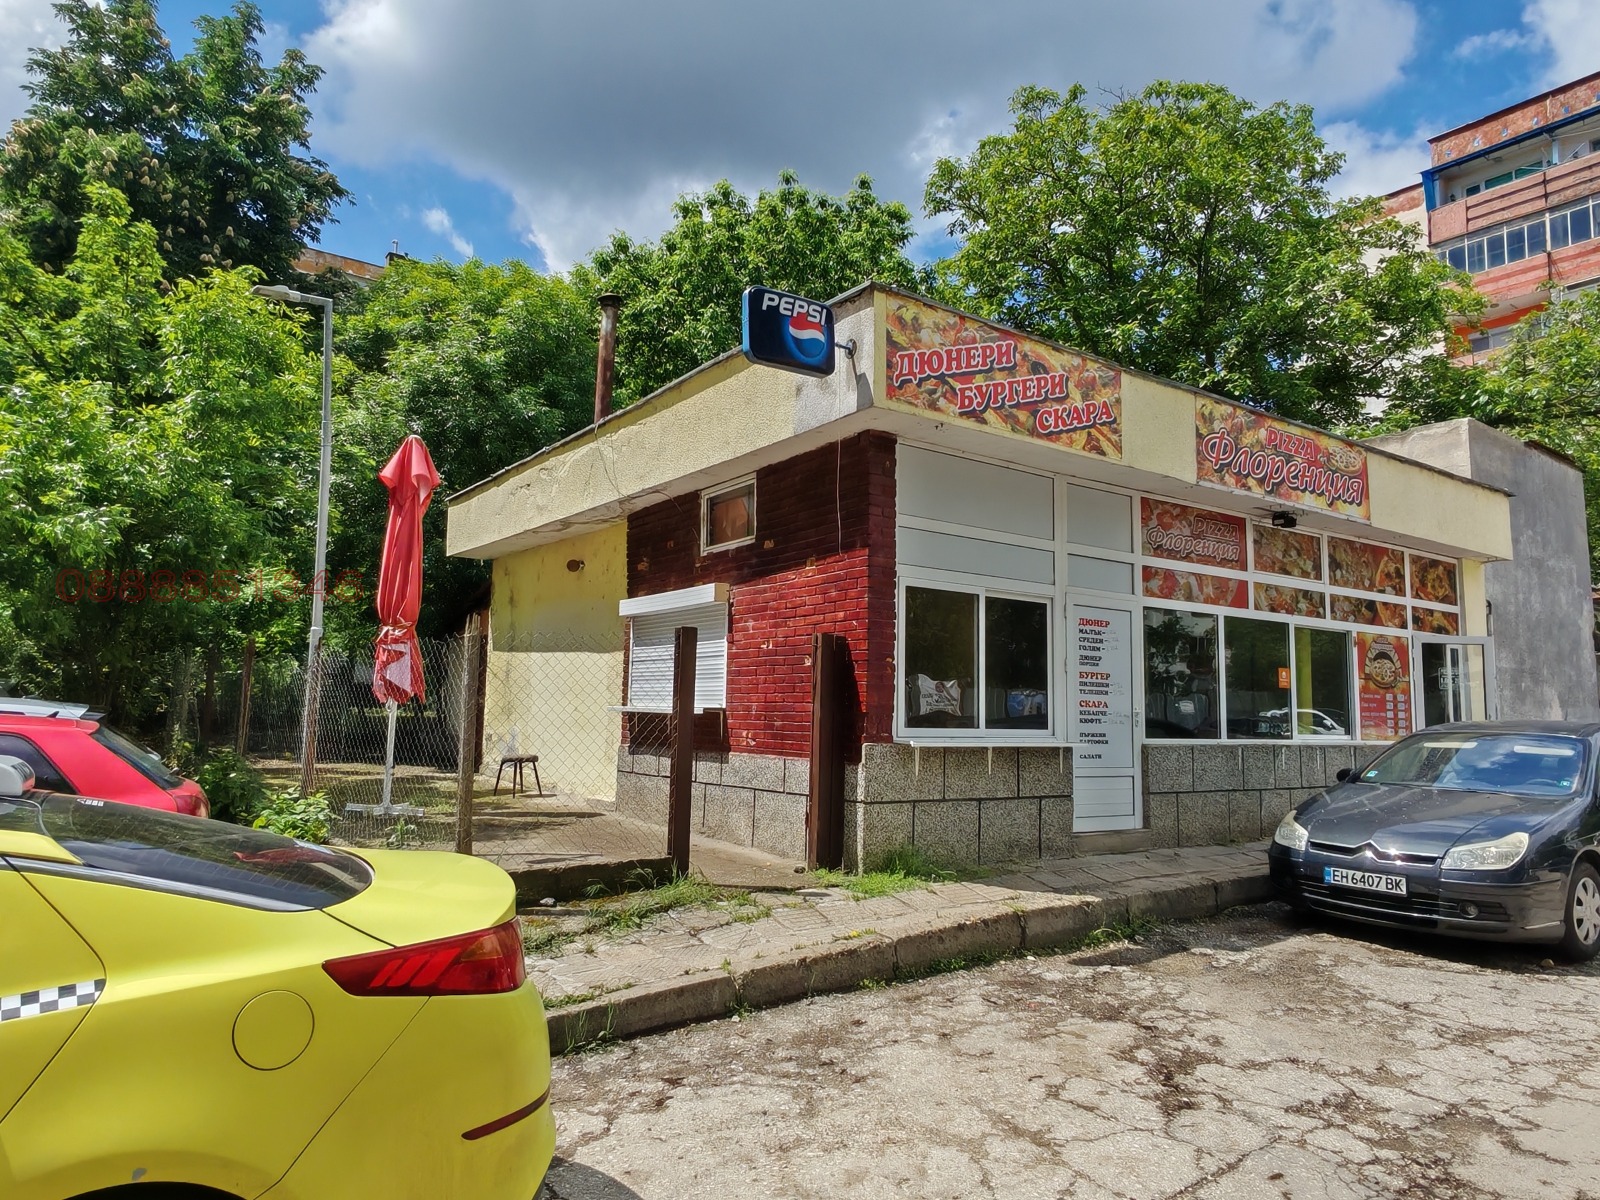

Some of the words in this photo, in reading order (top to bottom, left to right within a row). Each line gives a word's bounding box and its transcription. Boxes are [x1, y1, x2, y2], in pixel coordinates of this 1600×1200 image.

[761, 292, 828, 326] PEPSI
[894, 340, 1016, 386] ДЮНЕРИ
[956, 372, 1068, 412] БУРГЕРИ
[1035, 399, 1115, 433] СКАРА
[1265, 427, 1316, 462] PIZZA
[1202, 428, 1364, 504] Флоренция
[1147, 525, 1241, 561] Флоренция
[1193, 517, 1240, 542] PIZZA
[1078, 617, 1110, 628] ДЮНЕР
[1078, 671, 1111, 681] БУРГЕР
[1079, 700, 1109, 709] СКАРА
[1332, 869, 1349, 884] EH
[1351, 872, 1383, 889] 6407
[1385, 877, 1404, 893] BK
